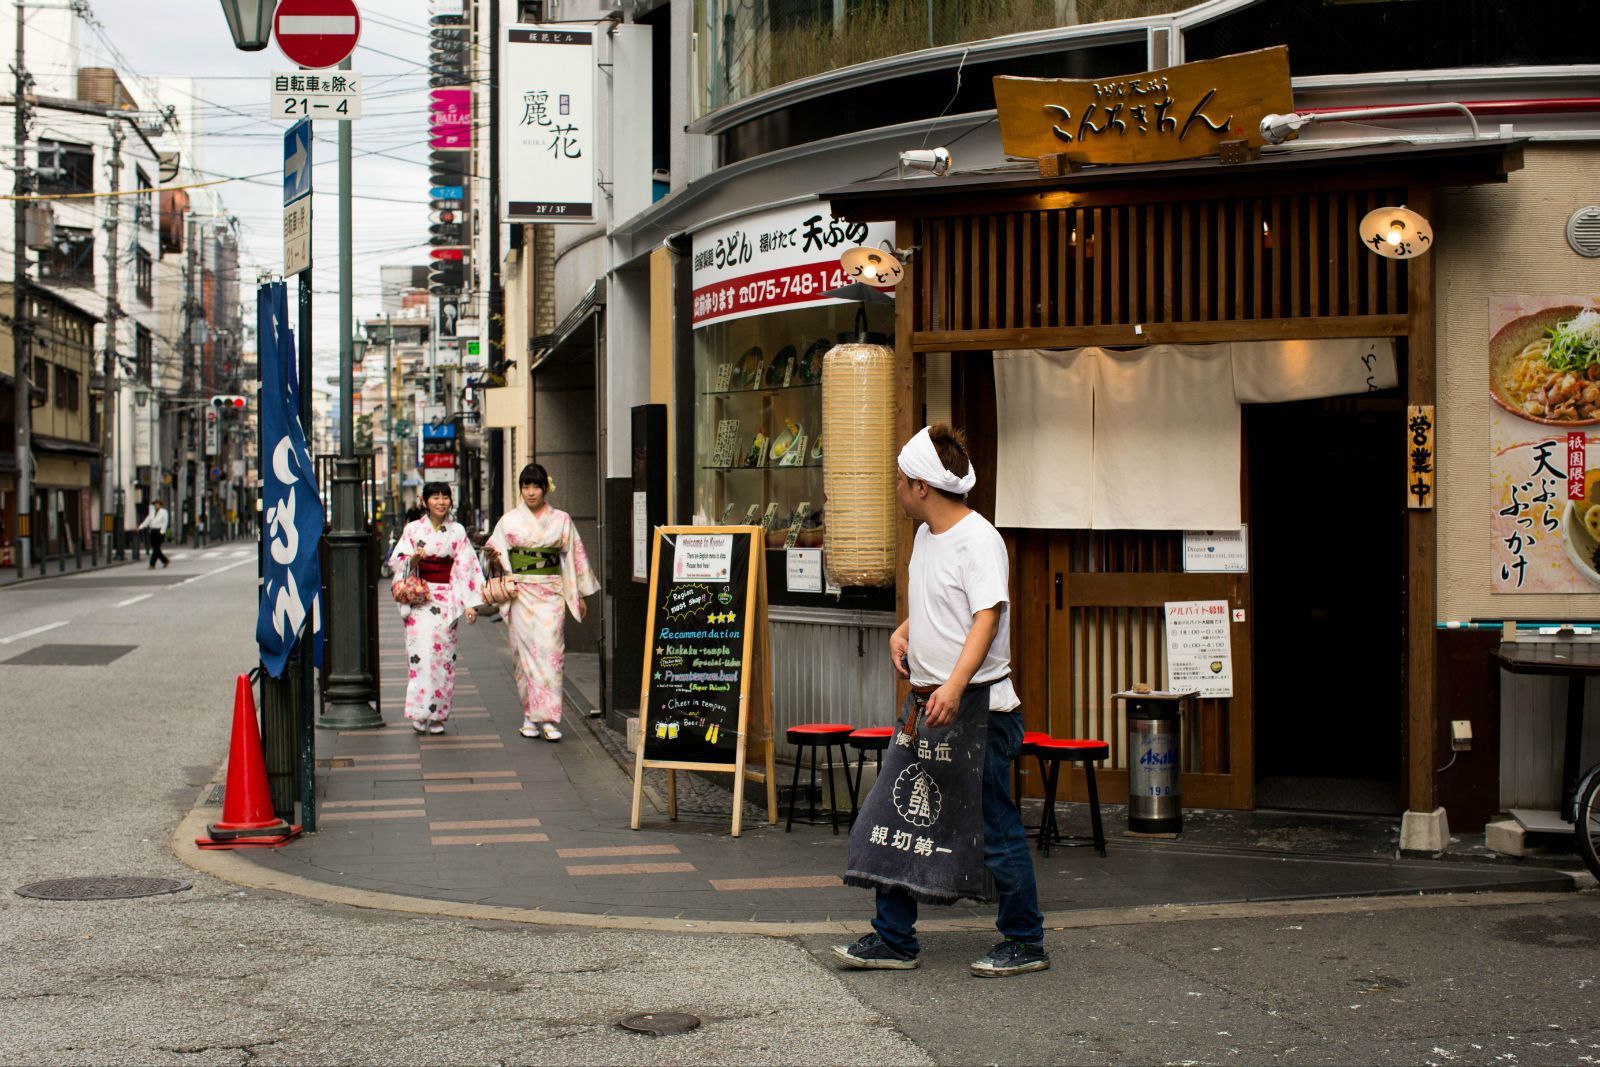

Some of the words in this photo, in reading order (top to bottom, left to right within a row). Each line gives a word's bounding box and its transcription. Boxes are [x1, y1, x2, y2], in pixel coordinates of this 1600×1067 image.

[275, 75, 356, 92] 自転車を除く
[536, 205, 547, 213] 2F
[555, 206, 567, 214] 3F
[1530, 441, 1568, 532] 天ぷら
[1500, 481, 1536, 588] ぶっかけ
[672, 589, 694, 601] Region
[659, 627, 740, 639] Recommendation
[870, 825, 952, 857] 親切第一
